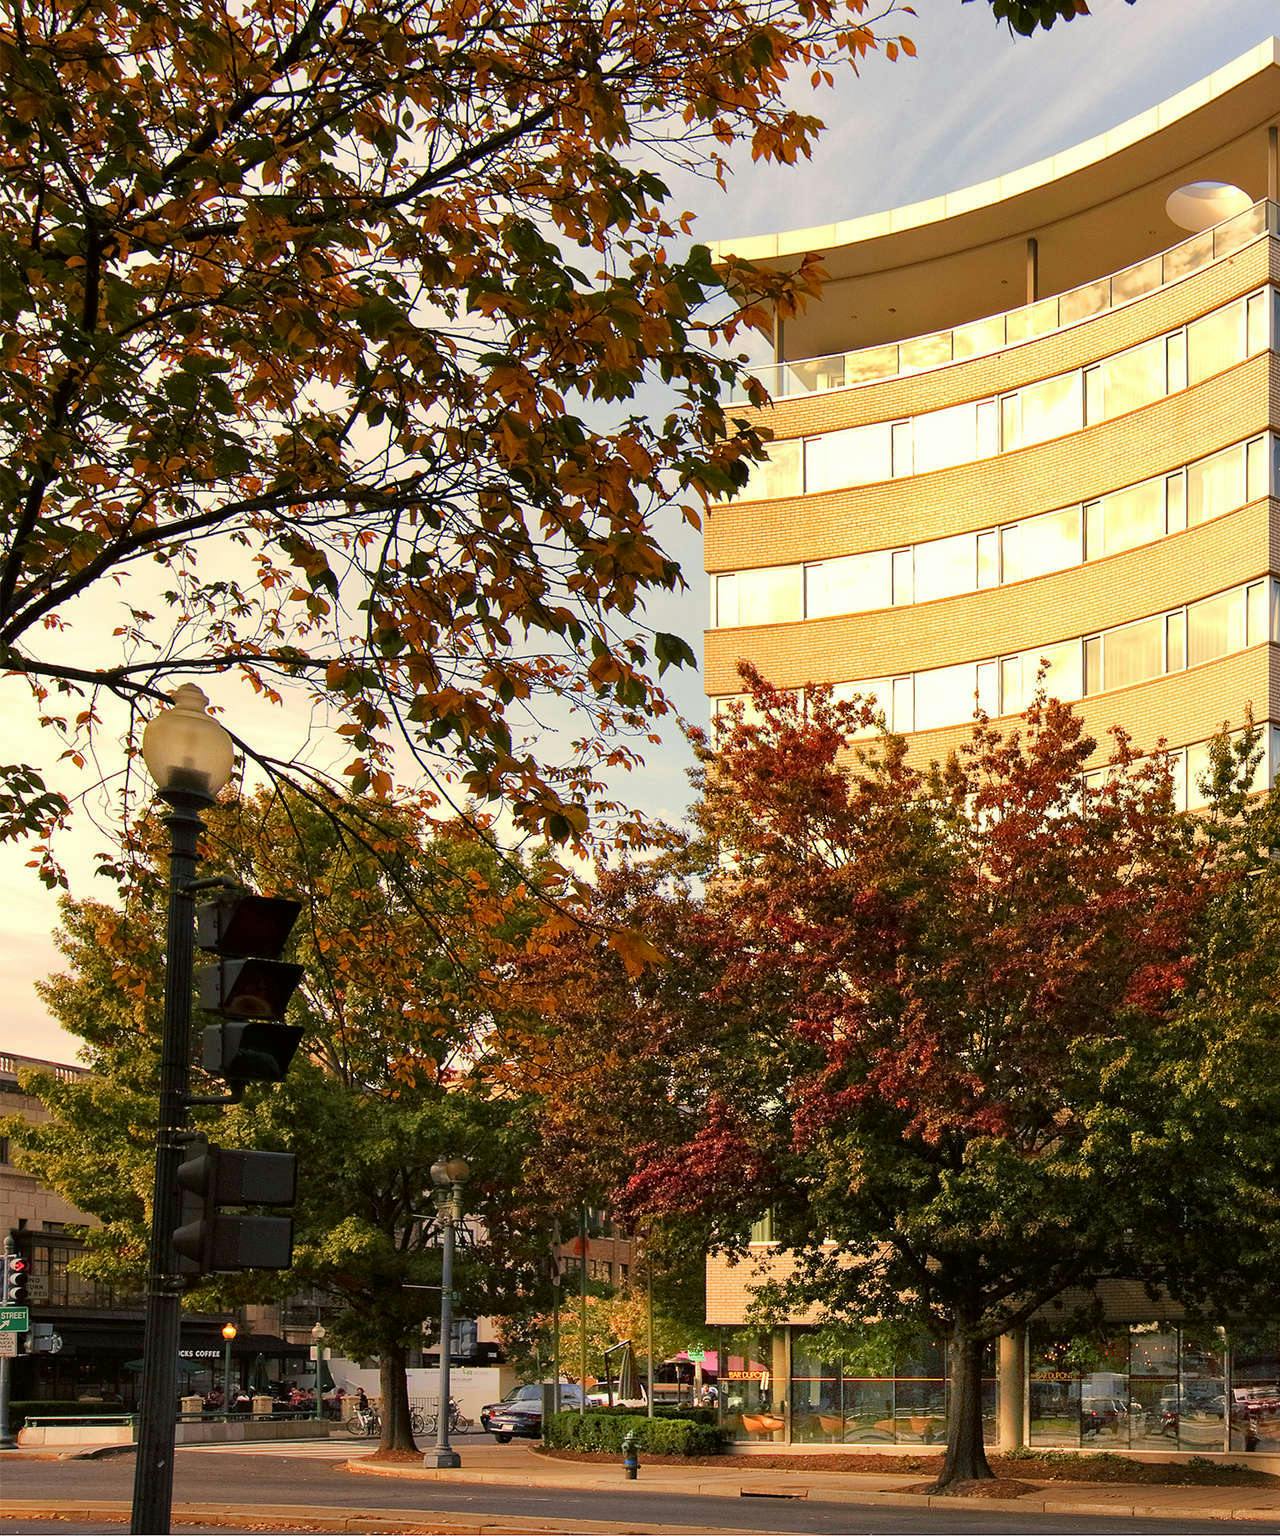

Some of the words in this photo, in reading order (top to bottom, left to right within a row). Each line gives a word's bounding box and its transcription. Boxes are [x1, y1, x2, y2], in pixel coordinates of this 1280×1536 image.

[1, 1311, 26, 1320] STREET
[195, 1350, 220, 1358] COFFEE
[728, 1371, 742, 1379] BAR
